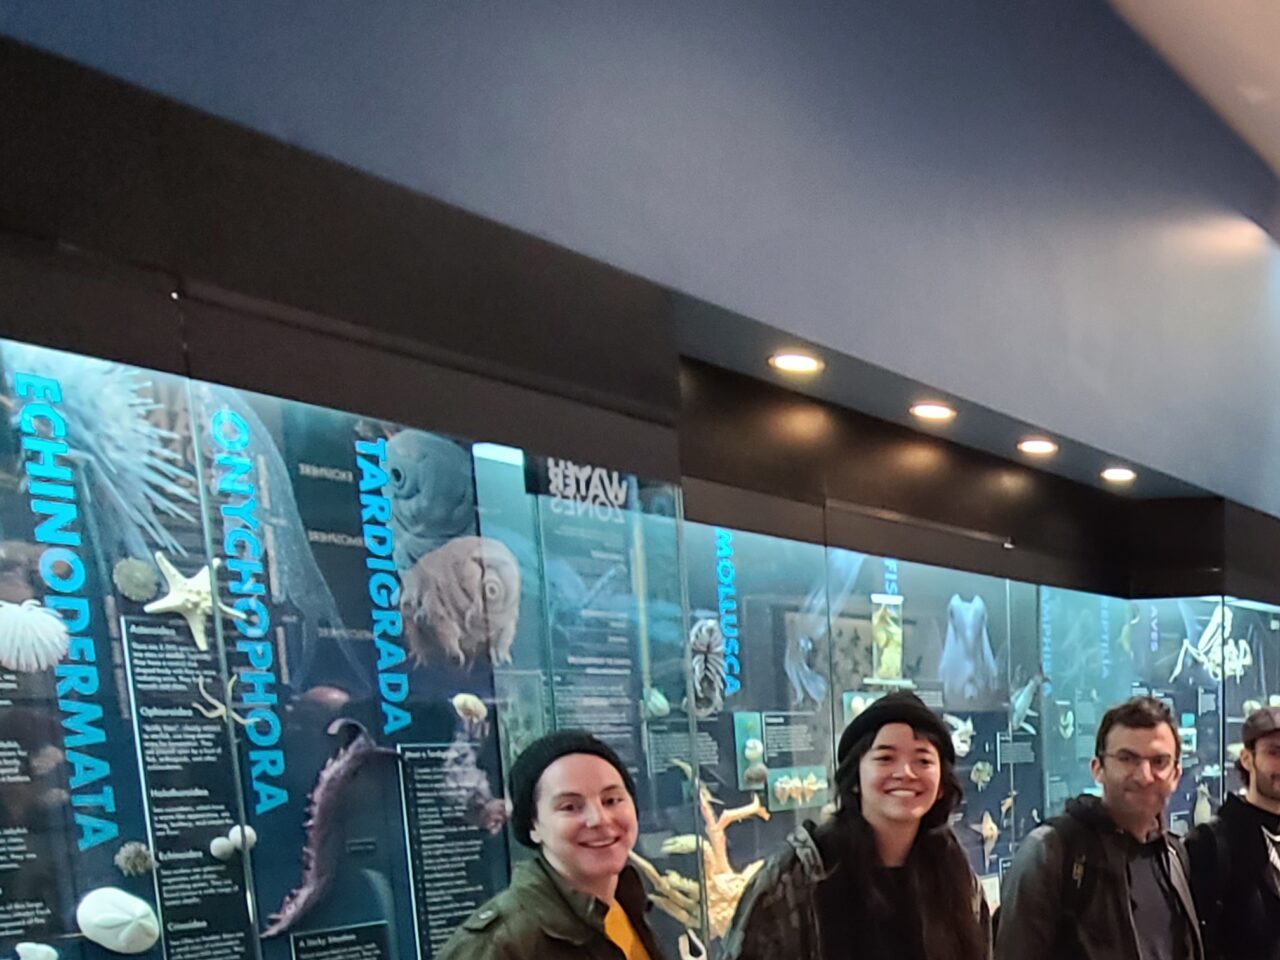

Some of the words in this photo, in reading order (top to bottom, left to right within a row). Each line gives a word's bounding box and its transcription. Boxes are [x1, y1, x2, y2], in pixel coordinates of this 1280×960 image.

[15, 371, 119, 852] ECHINODERMATA
[209, 408, 289, 816] ONYCHOPHORA
[354, 437, 413, 736] TARDIGRADA
[715, 527, 743, 697] MOLLUSCA
[884, 558, 900, 596] FIS
[1150, 605, 1160, 653] AVES
